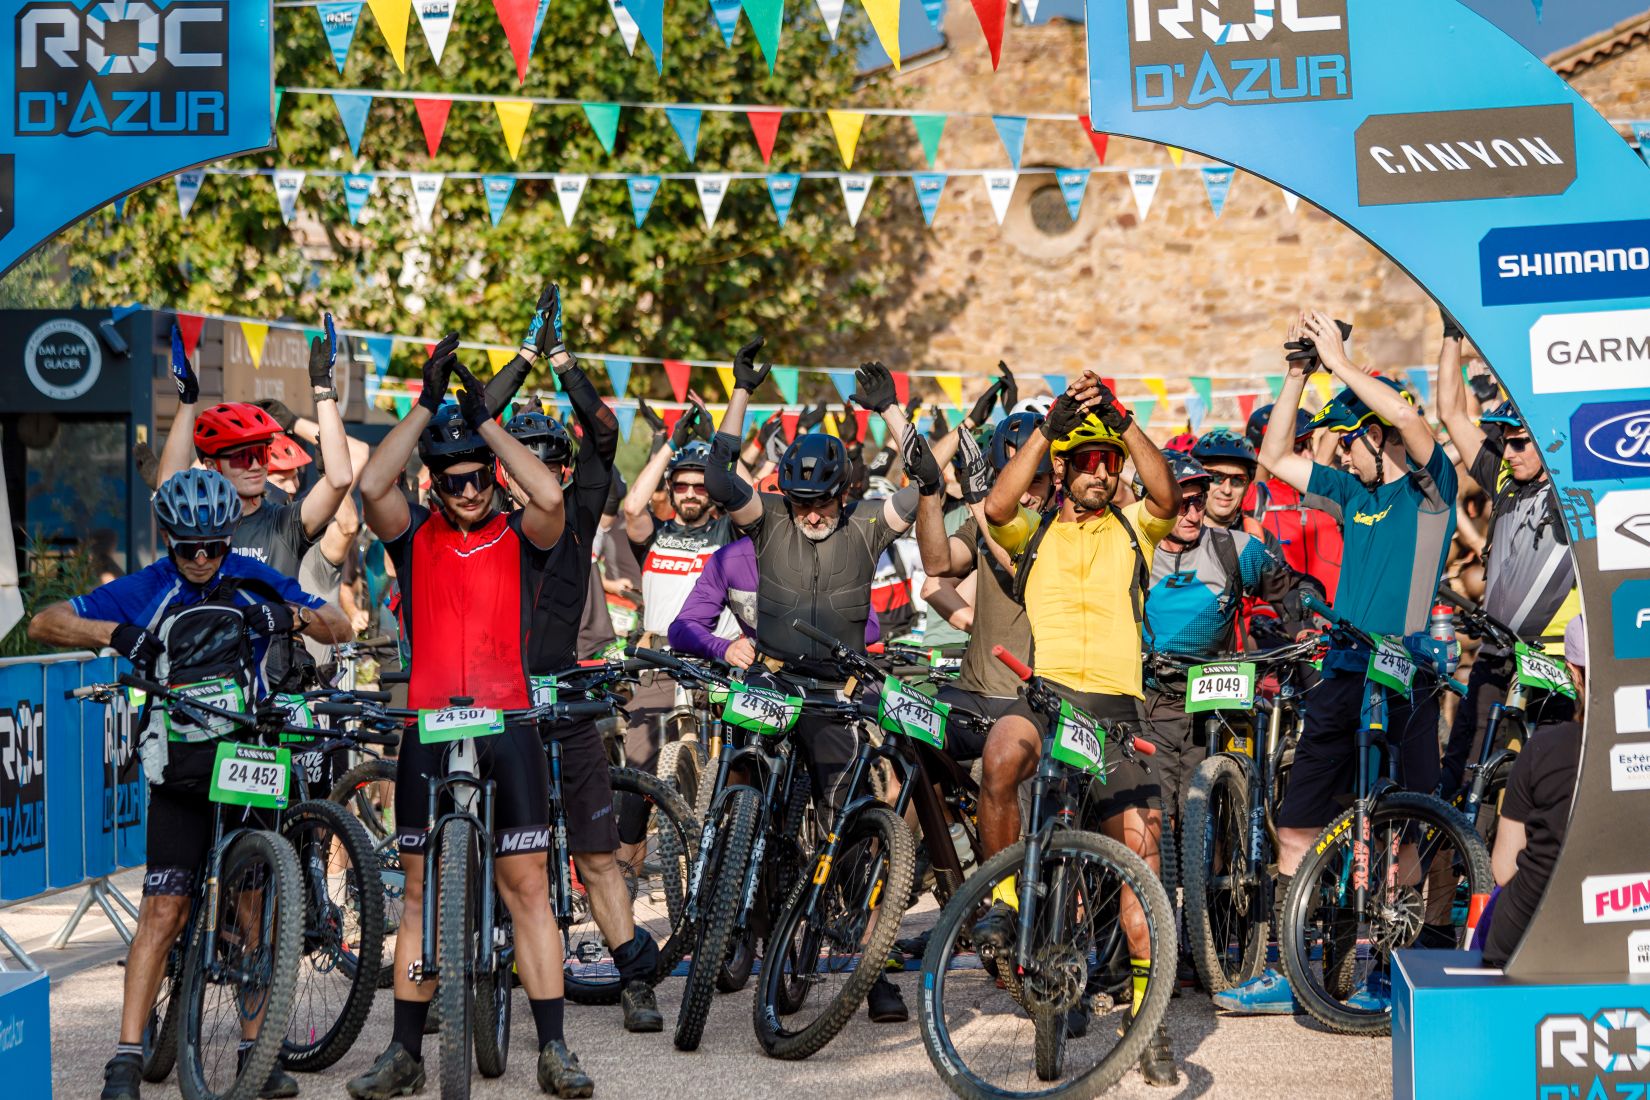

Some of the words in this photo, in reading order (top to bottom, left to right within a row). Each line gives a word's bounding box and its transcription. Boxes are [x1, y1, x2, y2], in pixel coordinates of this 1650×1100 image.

[21, 0, 223, 75] ROC
[1132, 0, 1342, 45] ROC
[1136, 50, 1347, 107] D'AZUR
[19, 79, 225, 132] D'AZUR
[1369, 136, 1564, 175] CANYON
[1498, 246, 1649, 278] SHIMANO
[1203, 665, 1238, 674] CANYON
[1198, 678, 1213, 695] 24
[1216, 677, 1240, 692] 049
[436, 711, 454, 723] 24
[459, 709, 486, 721] 507
[741, 694, 757, 711] 24
[897, 697, 912, 716] 24
[915, 706, 933, 726] 421
[1072, 725, 1084, 746] 24
[237, 749, 275, 760] CANYON
[229, 763, 248, 783] 24
[252, 766, 278, 786] 452
[786, 874, 809, 910] BUTCHER
[924, 988, 959, 1076] SCHWALBE
